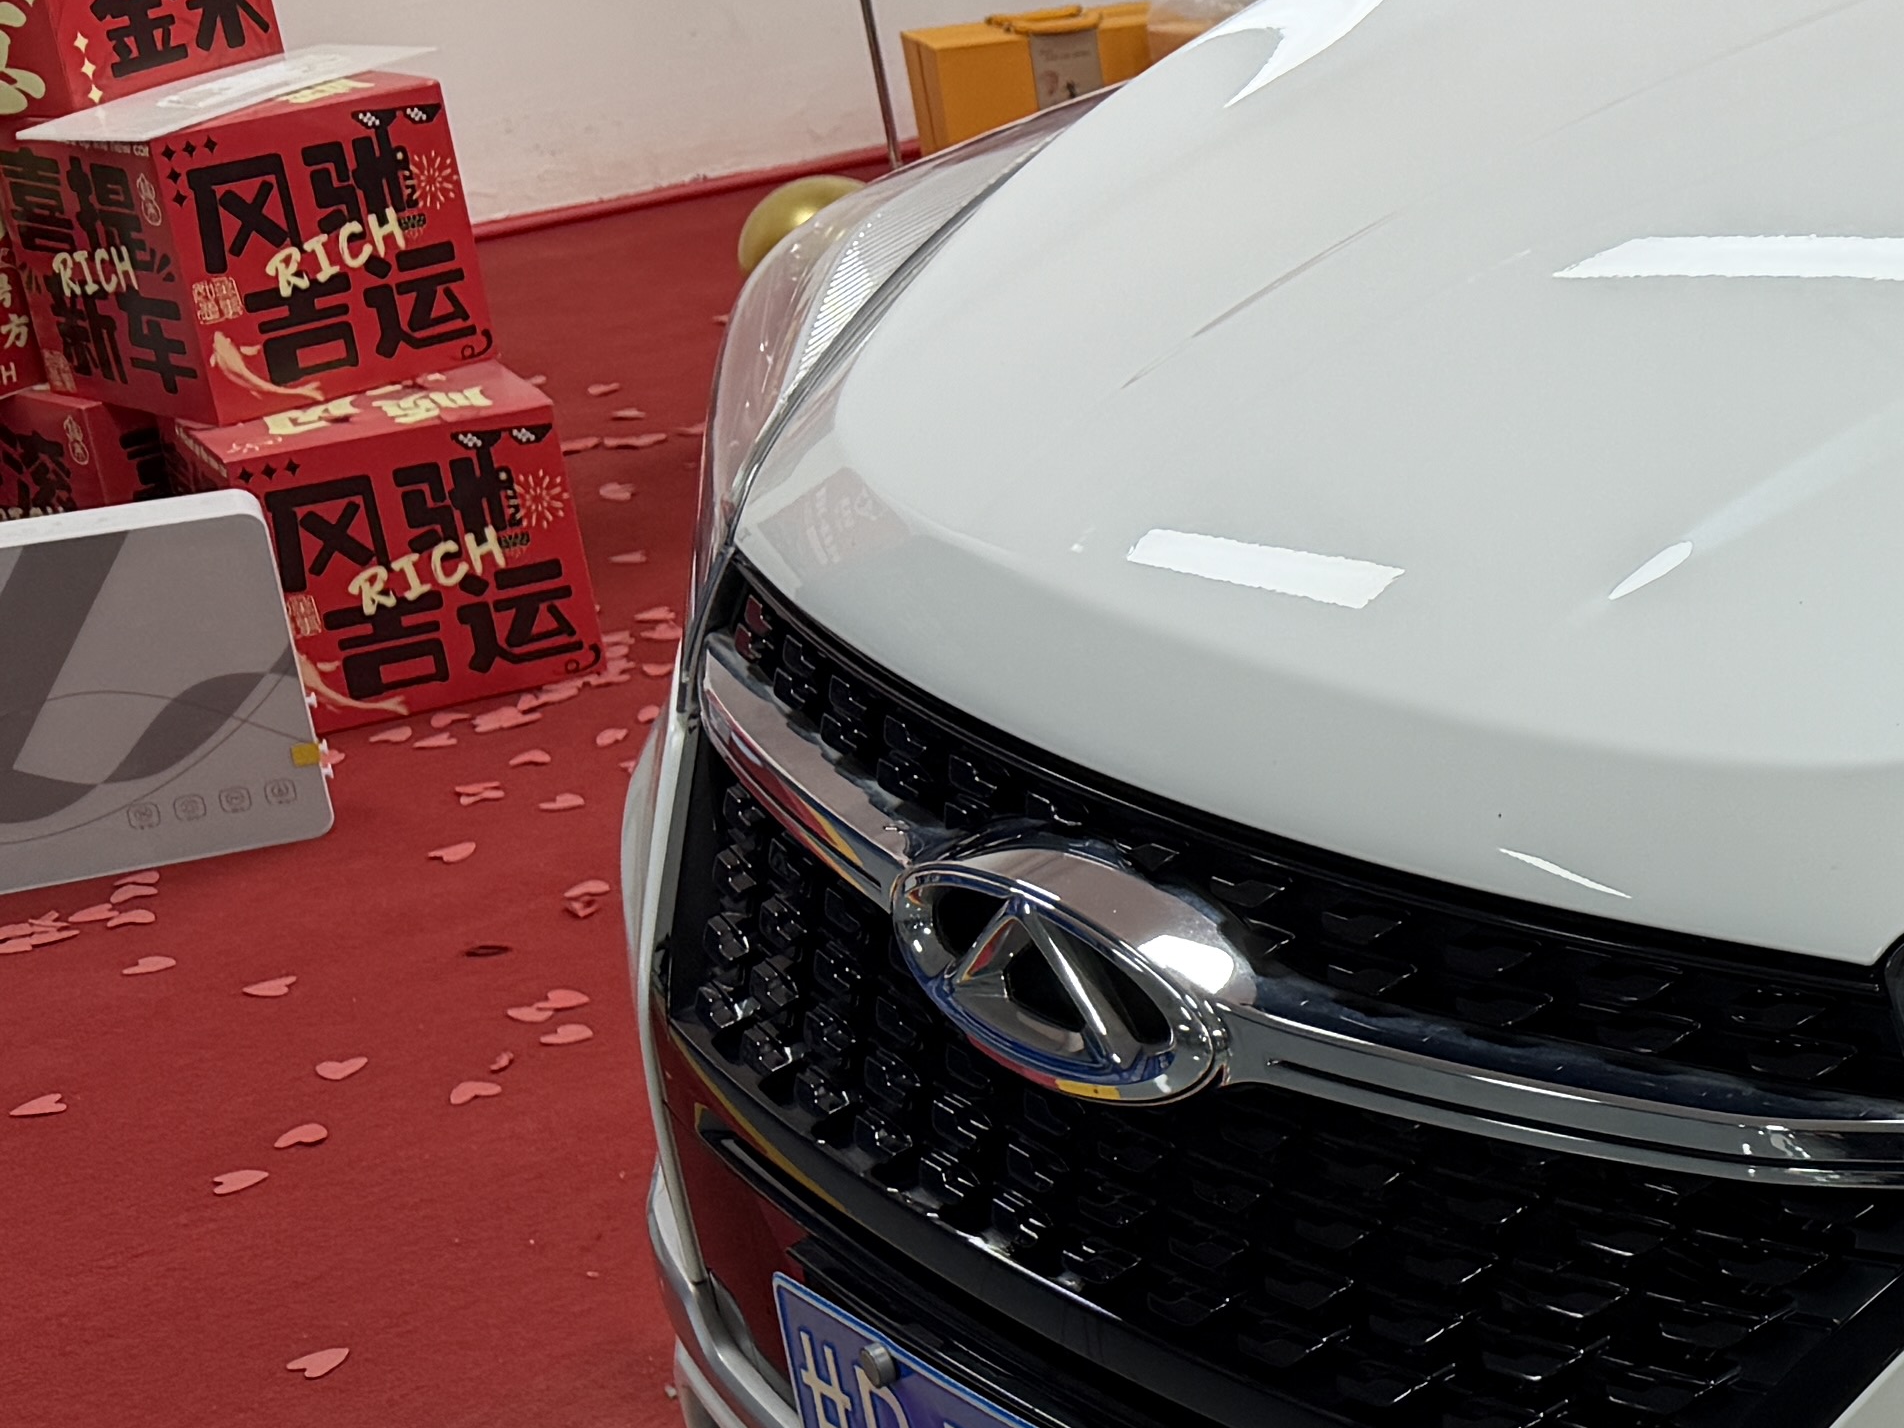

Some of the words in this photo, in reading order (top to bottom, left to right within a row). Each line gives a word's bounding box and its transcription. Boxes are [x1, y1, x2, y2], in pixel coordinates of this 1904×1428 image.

[52, 245, 140, 298] RICH
[265, 206, 406, 298] RICH
[243, 240, 480, 386] 吉运
[348, 525, 506, 616] RICH
[322, 558, 585, 700] 吉运
